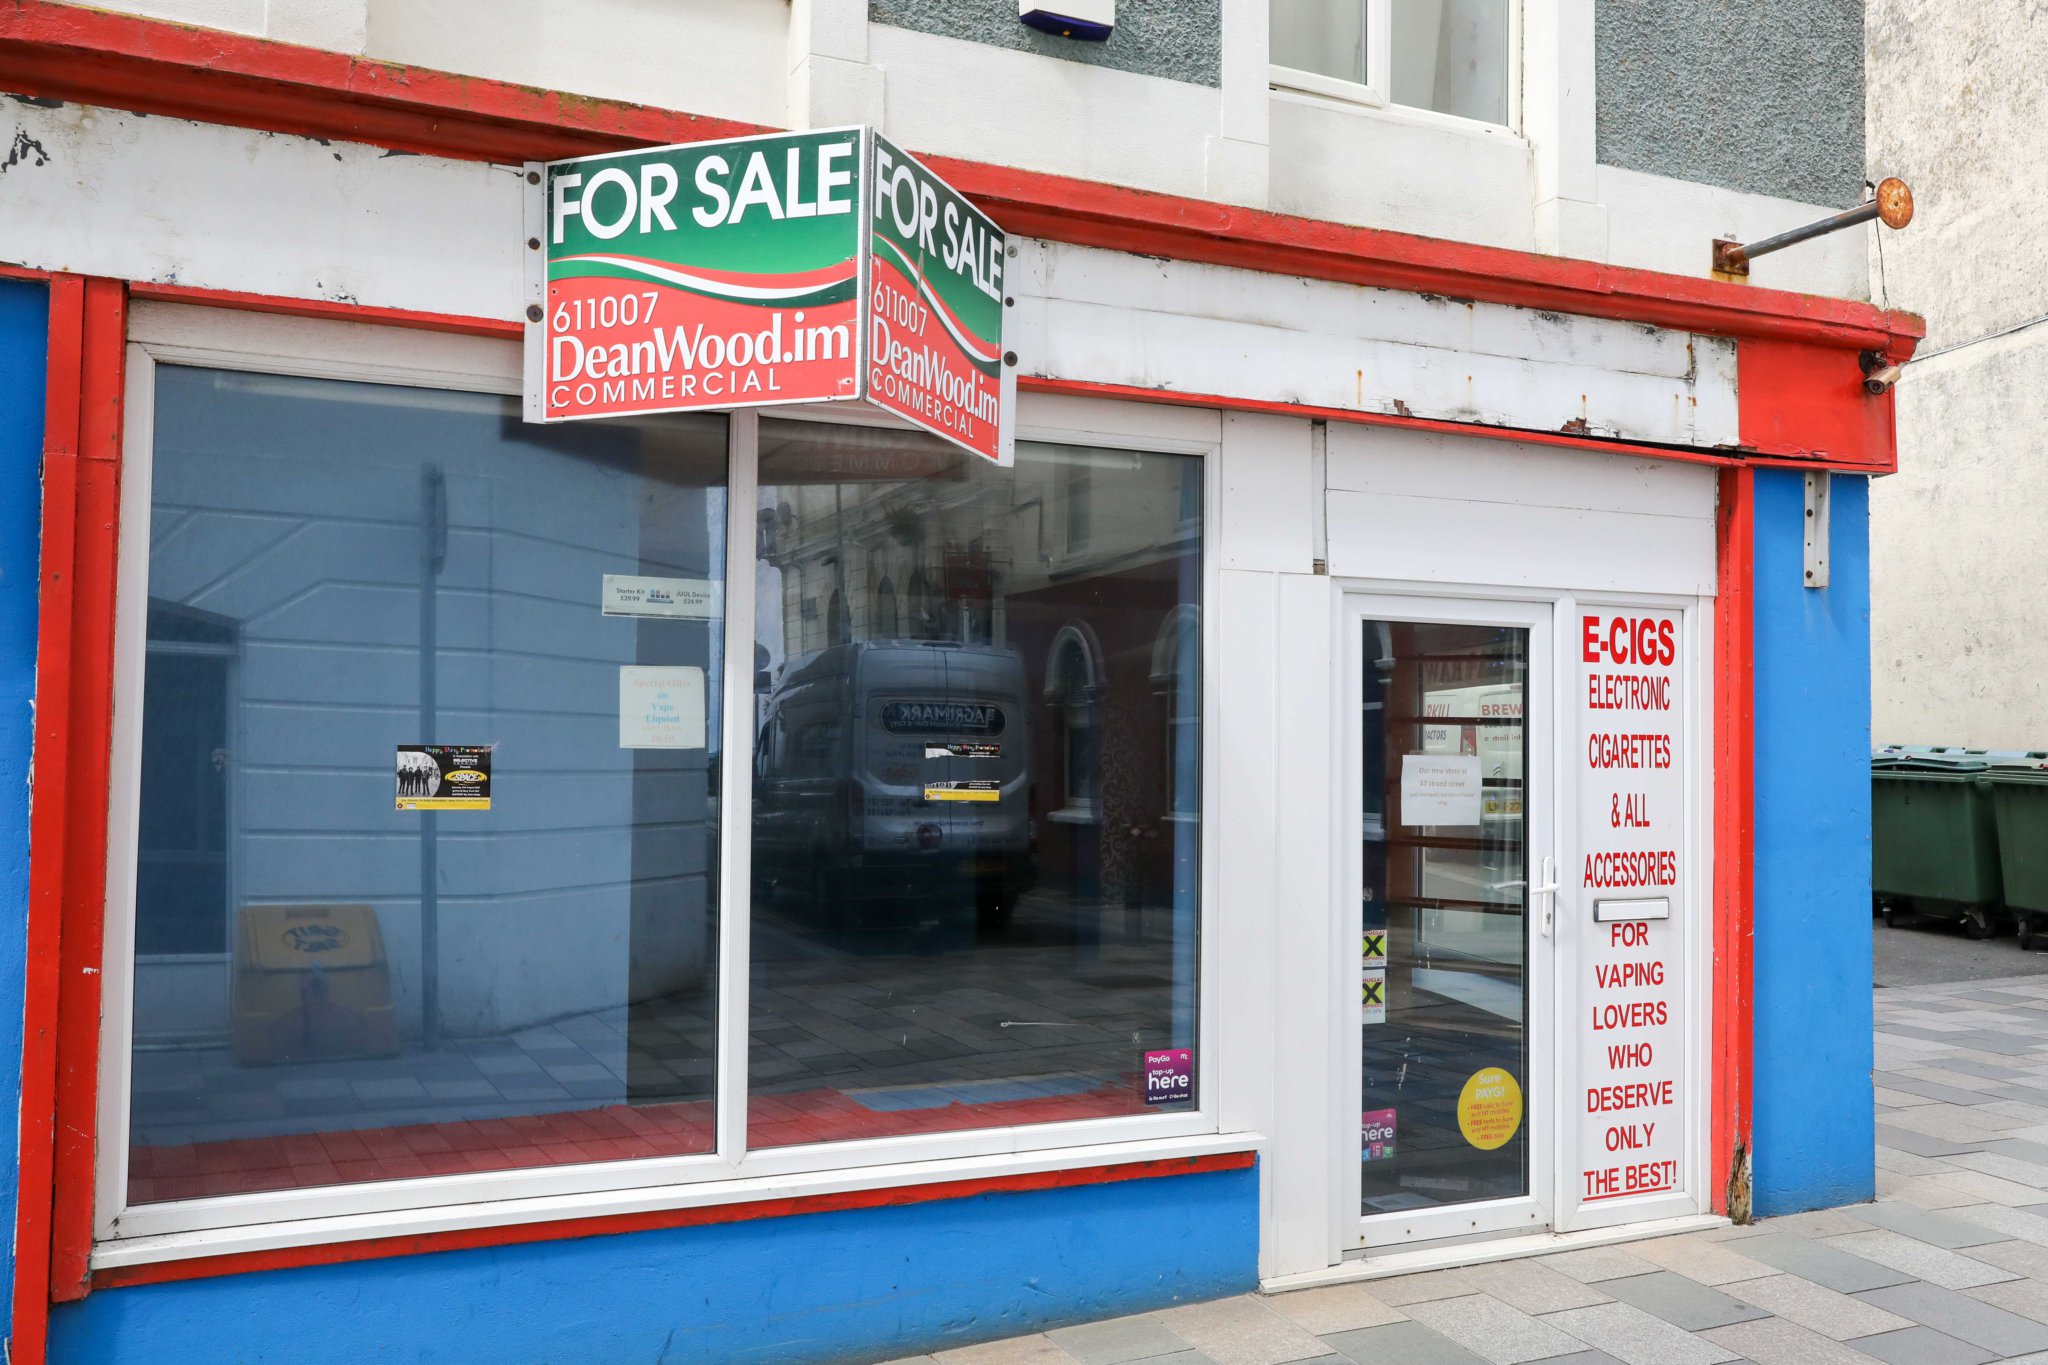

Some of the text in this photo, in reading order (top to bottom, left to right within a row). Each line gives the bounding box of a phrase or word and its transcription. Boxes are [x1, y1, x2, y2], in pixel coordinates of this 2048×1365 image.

[553, 142, 853, 244] FOR SALE
[875, 146, 1002, 303] FOR SALE
[553, 292, 659, 332] 611007
[874, 281, 927, 337] 611007
[552, 312, 850, 382] DeanWood.im
[873, 314, 998, 427] DeanWood.im
[551, 369, 781, 408] COMMERCIAL
[872, 368, 974, 439] COMMERCIAL
[616, 587, 636, 595] Starter
[1582, 615, 1675, 667] E-CIGS
[652, 703, 675, 712] Vape
[1589, 674, 1670, 711] ELECTRONIC
[1589, 733, 1671, 769] CIGARETTES
[1611, 793, 1650, 828] & ALL
[1583, 851, 1676, 888] ACCESSORIES
[1611, 922, 1649, 947] FOR
[1596, 961, 1664, 989] VAPING
[1593, 1001, 1668, 1030] LOVERS
[1148, 1055, 1171, 1064] PayGo
[1152, 1068, 1174, 1076] top-up
[1608, 1042, 1653, 1070] WHO
[1148, 1072, 1189, 1090] here
[1475, 1086, 1505, 1100] PAYG!
[1478, 1073, 1502, 1085] Sure
[1587, 1081, 1673, 1113] DESERVE
[1605, 1123, 1655, 1152] ONLY
[1583, 1160, 1677, 1196] THE BEST!
